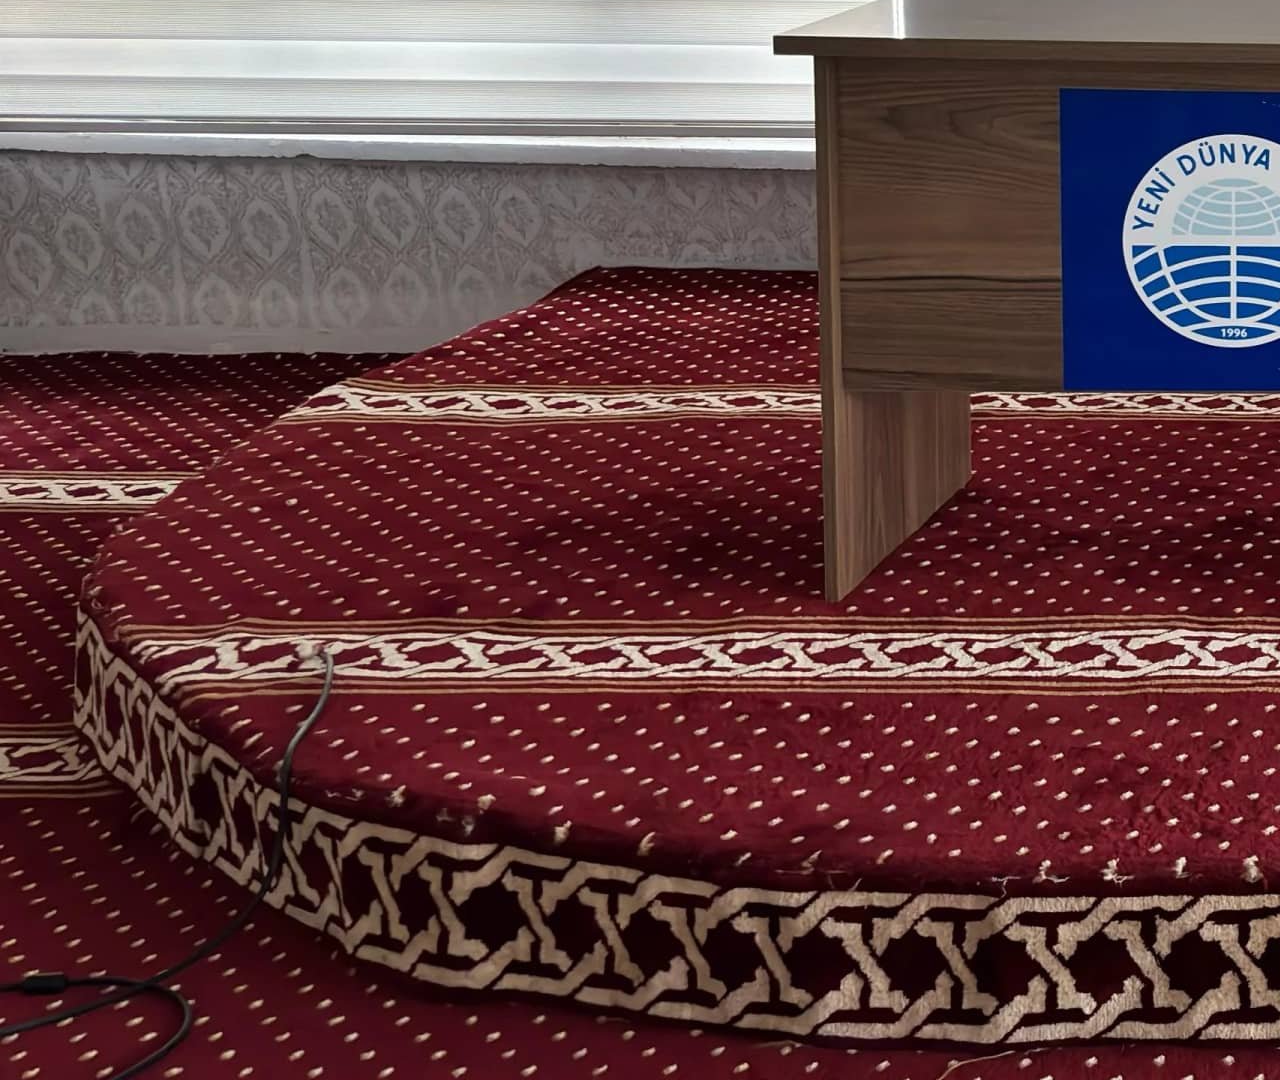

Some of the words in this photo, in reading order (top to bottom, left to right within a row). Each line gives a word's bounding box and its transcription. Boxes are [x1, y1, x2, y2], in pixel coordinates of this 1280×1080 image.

[1132, 167, 1176, 232] YENİ
[1176, 141, 1271, 177] DÜNYA
[1220, 328, 1249, 339] 1996
